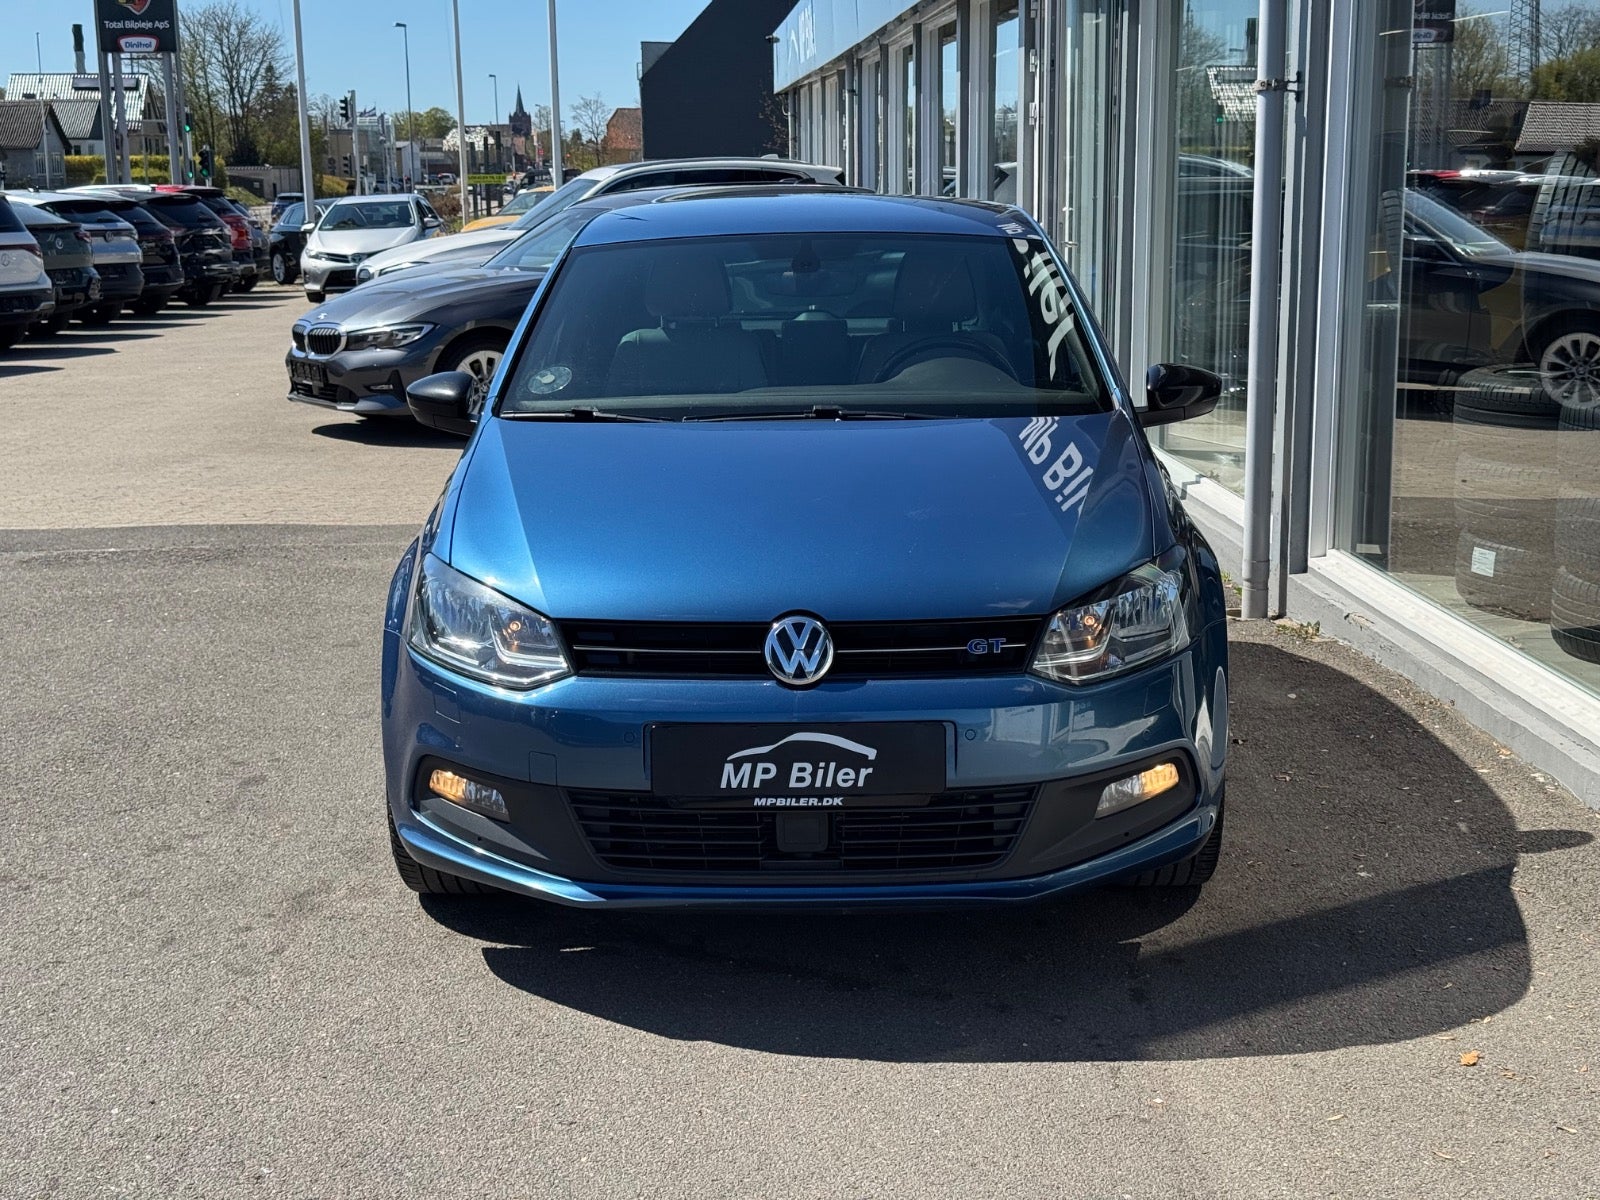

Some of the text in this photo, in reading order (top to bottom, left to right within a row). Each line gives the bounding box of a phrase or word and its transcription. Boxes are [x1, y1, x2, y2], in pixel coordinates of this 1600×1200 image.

[104, 20, 170, 30] Total Bilpleje ApS
[125, 41, 152, 49] Dinitrol
[966, 637, 1007, 655] GT
[720, 761, 873, 789] MP Biler
[753, 797, 844, 807] MPBILER.DK
